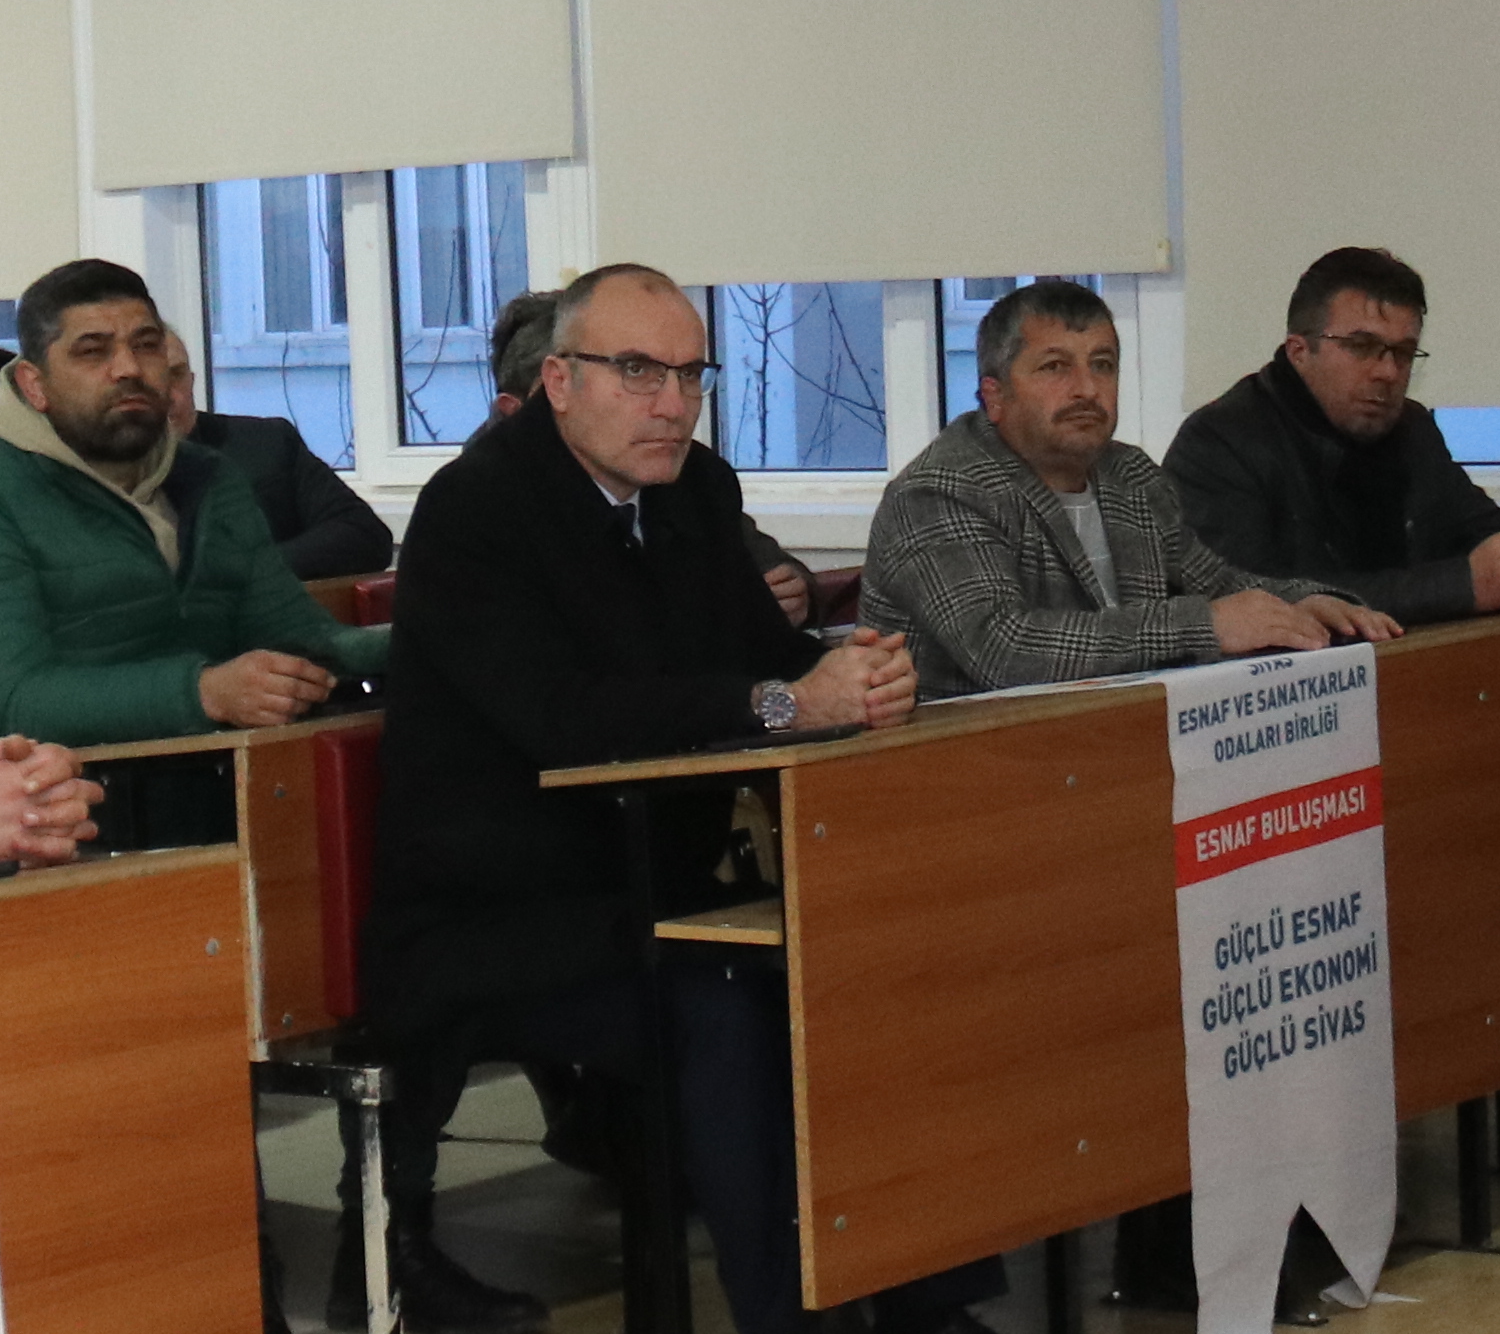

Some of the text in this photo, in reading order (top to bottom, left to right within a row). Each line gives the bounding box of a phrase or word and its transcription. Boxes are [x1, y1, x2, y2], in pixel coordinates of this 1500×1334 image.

[1178, 665, 1368, 735] ESNAF VE SANATKARLAR
[1214, 703, 1338, 763] ODALARI BİRLİĞİ
[1195, 785, 1366, 862] ESNAF BULUŞMASI
[1215, 891, 1362, 971] GÜÇLÜ ESNAF
[1202, 931, 1377, 1032] GÜÇLÜ EKONOMİ
[1224, 1000, 1366, 1079] GÜÇLÜ SİVAS
